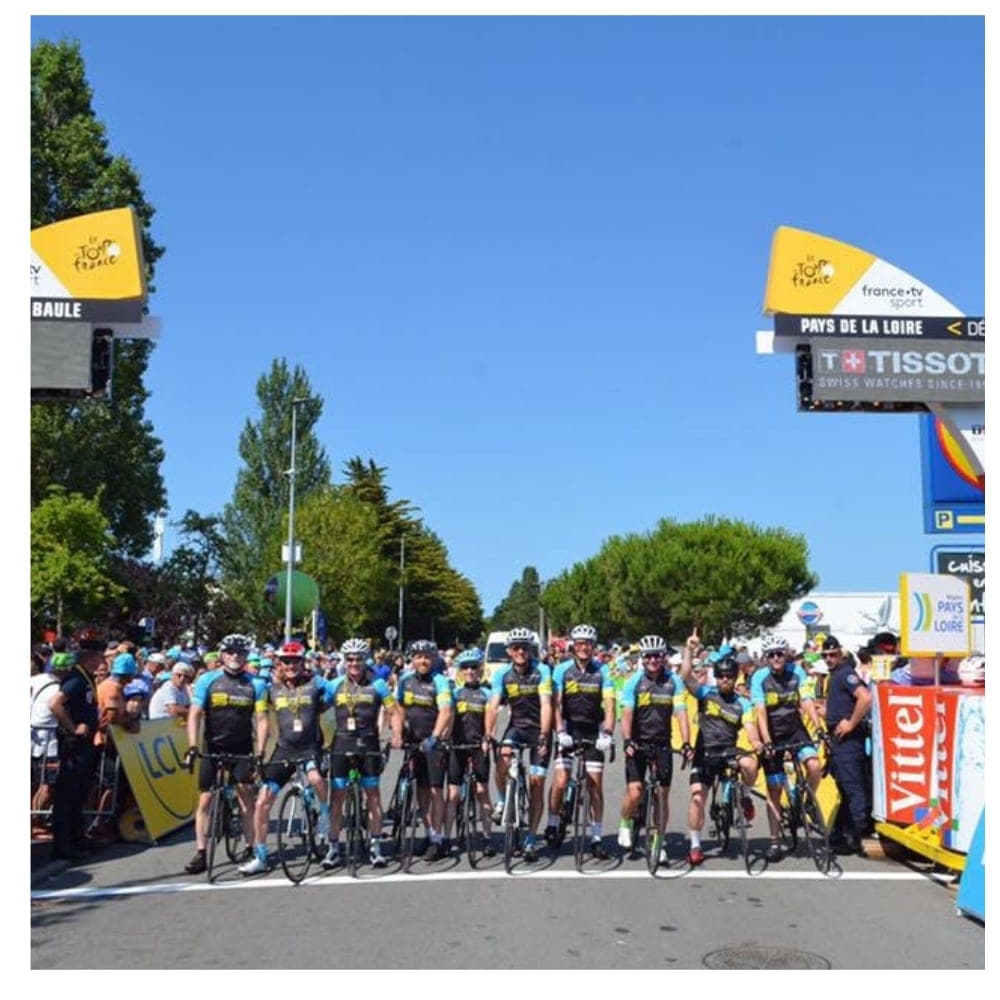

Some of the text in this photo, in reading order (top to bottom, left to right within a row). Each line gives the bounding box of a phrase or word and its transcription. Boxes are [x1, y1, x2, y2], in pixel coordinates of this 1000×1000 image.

[32, 301, 83, 318] BAULE
[890, 298, 923, 310] sport
[800, 319, 924, 335] PAYS DE LA LOIRE
[867, 351, 985, 375] TISSOT
[818, 377, 859, 388] SWISS
[863, 378, 922, 389] WATCHES
[927, 379, 965, 389] SINCE
[937, 601, 964, 613] PAYS
[934, 620, 964, 632] LOIRE
[137, 735, 188, 779] LCL
[889, 693, 926, 813] Vittel
